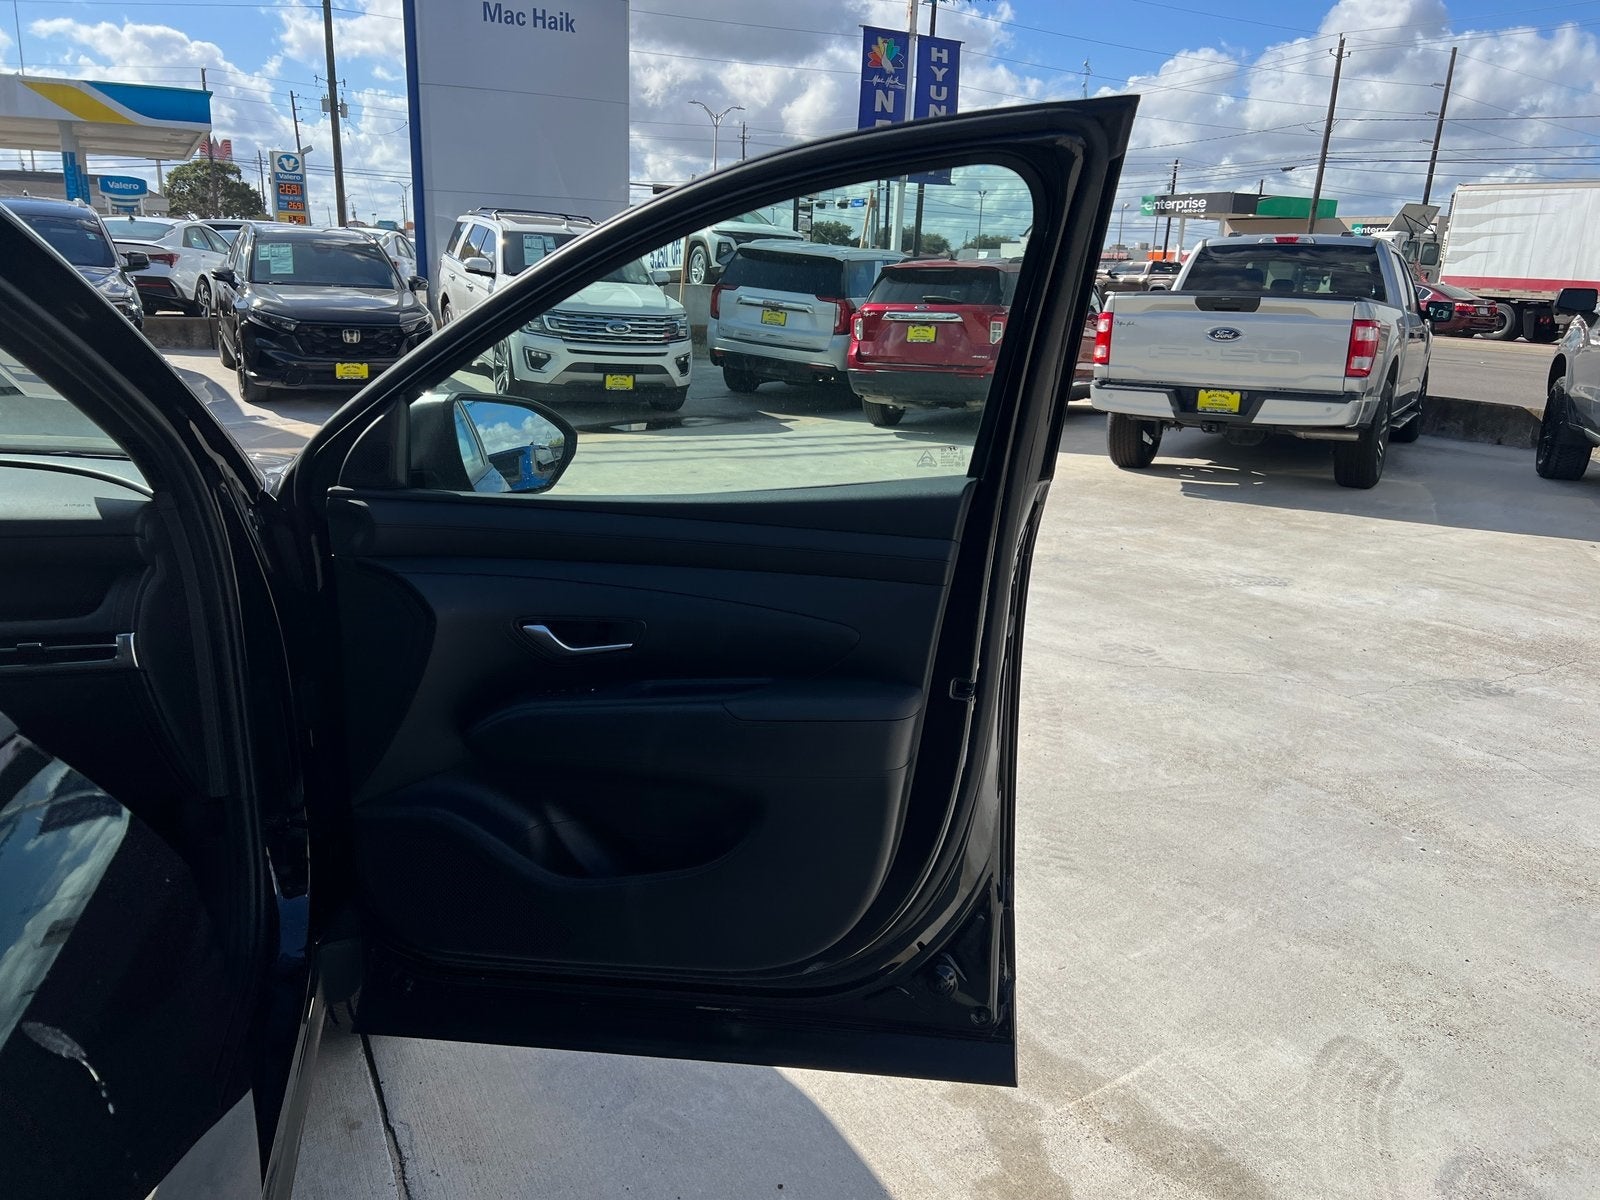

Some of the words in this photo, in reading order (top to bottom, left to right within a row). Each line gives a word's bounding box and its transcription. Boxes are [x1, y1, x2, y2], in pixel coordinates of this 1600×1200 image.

[482, 1, 526, 26] Mac
[532, 8, 576, 33] Haik
[278, 173, 301, 181] Valero
[107, 181, 140, 190] Valero
[1141, 197, 1207, 212] enterprise
[1214, 330, 1234, 339] Ford
